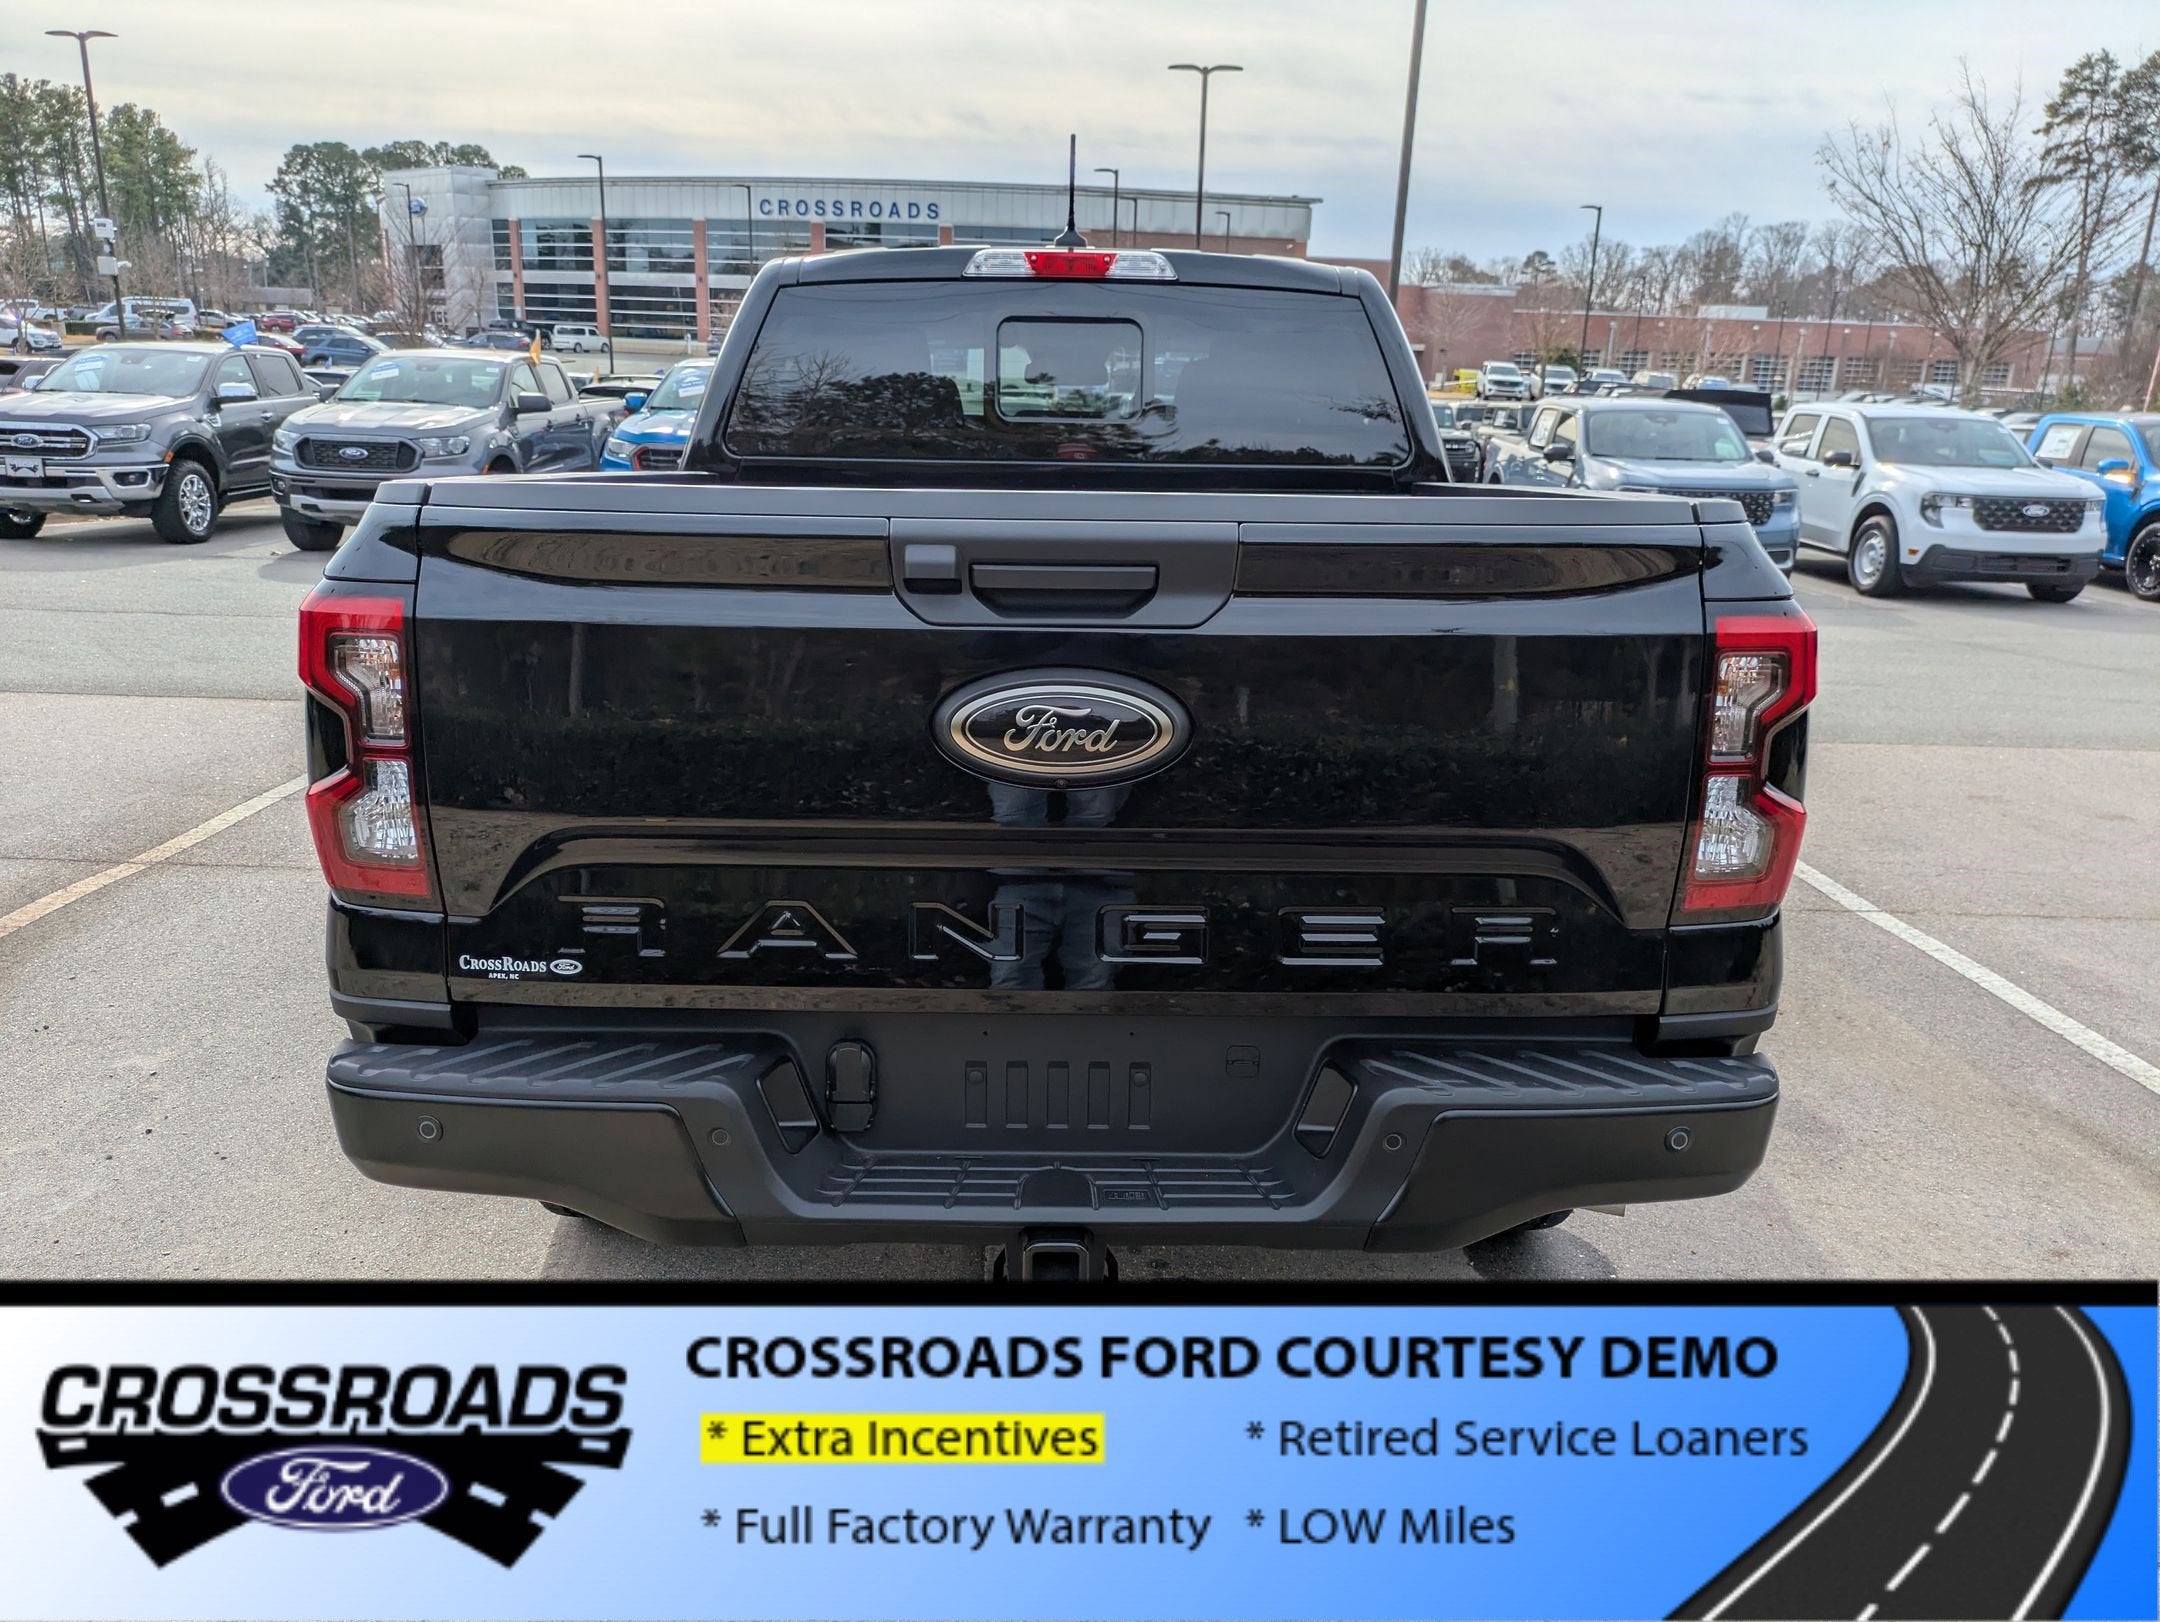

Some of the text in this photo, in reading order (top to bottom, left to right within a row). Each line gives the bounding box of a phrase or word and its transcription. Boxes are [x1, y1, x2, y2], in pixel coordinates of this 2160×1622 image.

[759, 199, 940, 220] CROSSROADS
[1003, 704, 1121, 752] Ford
[557, 895, 1558, 966] RANGER
[488, 972, 508, 980] APEX,
